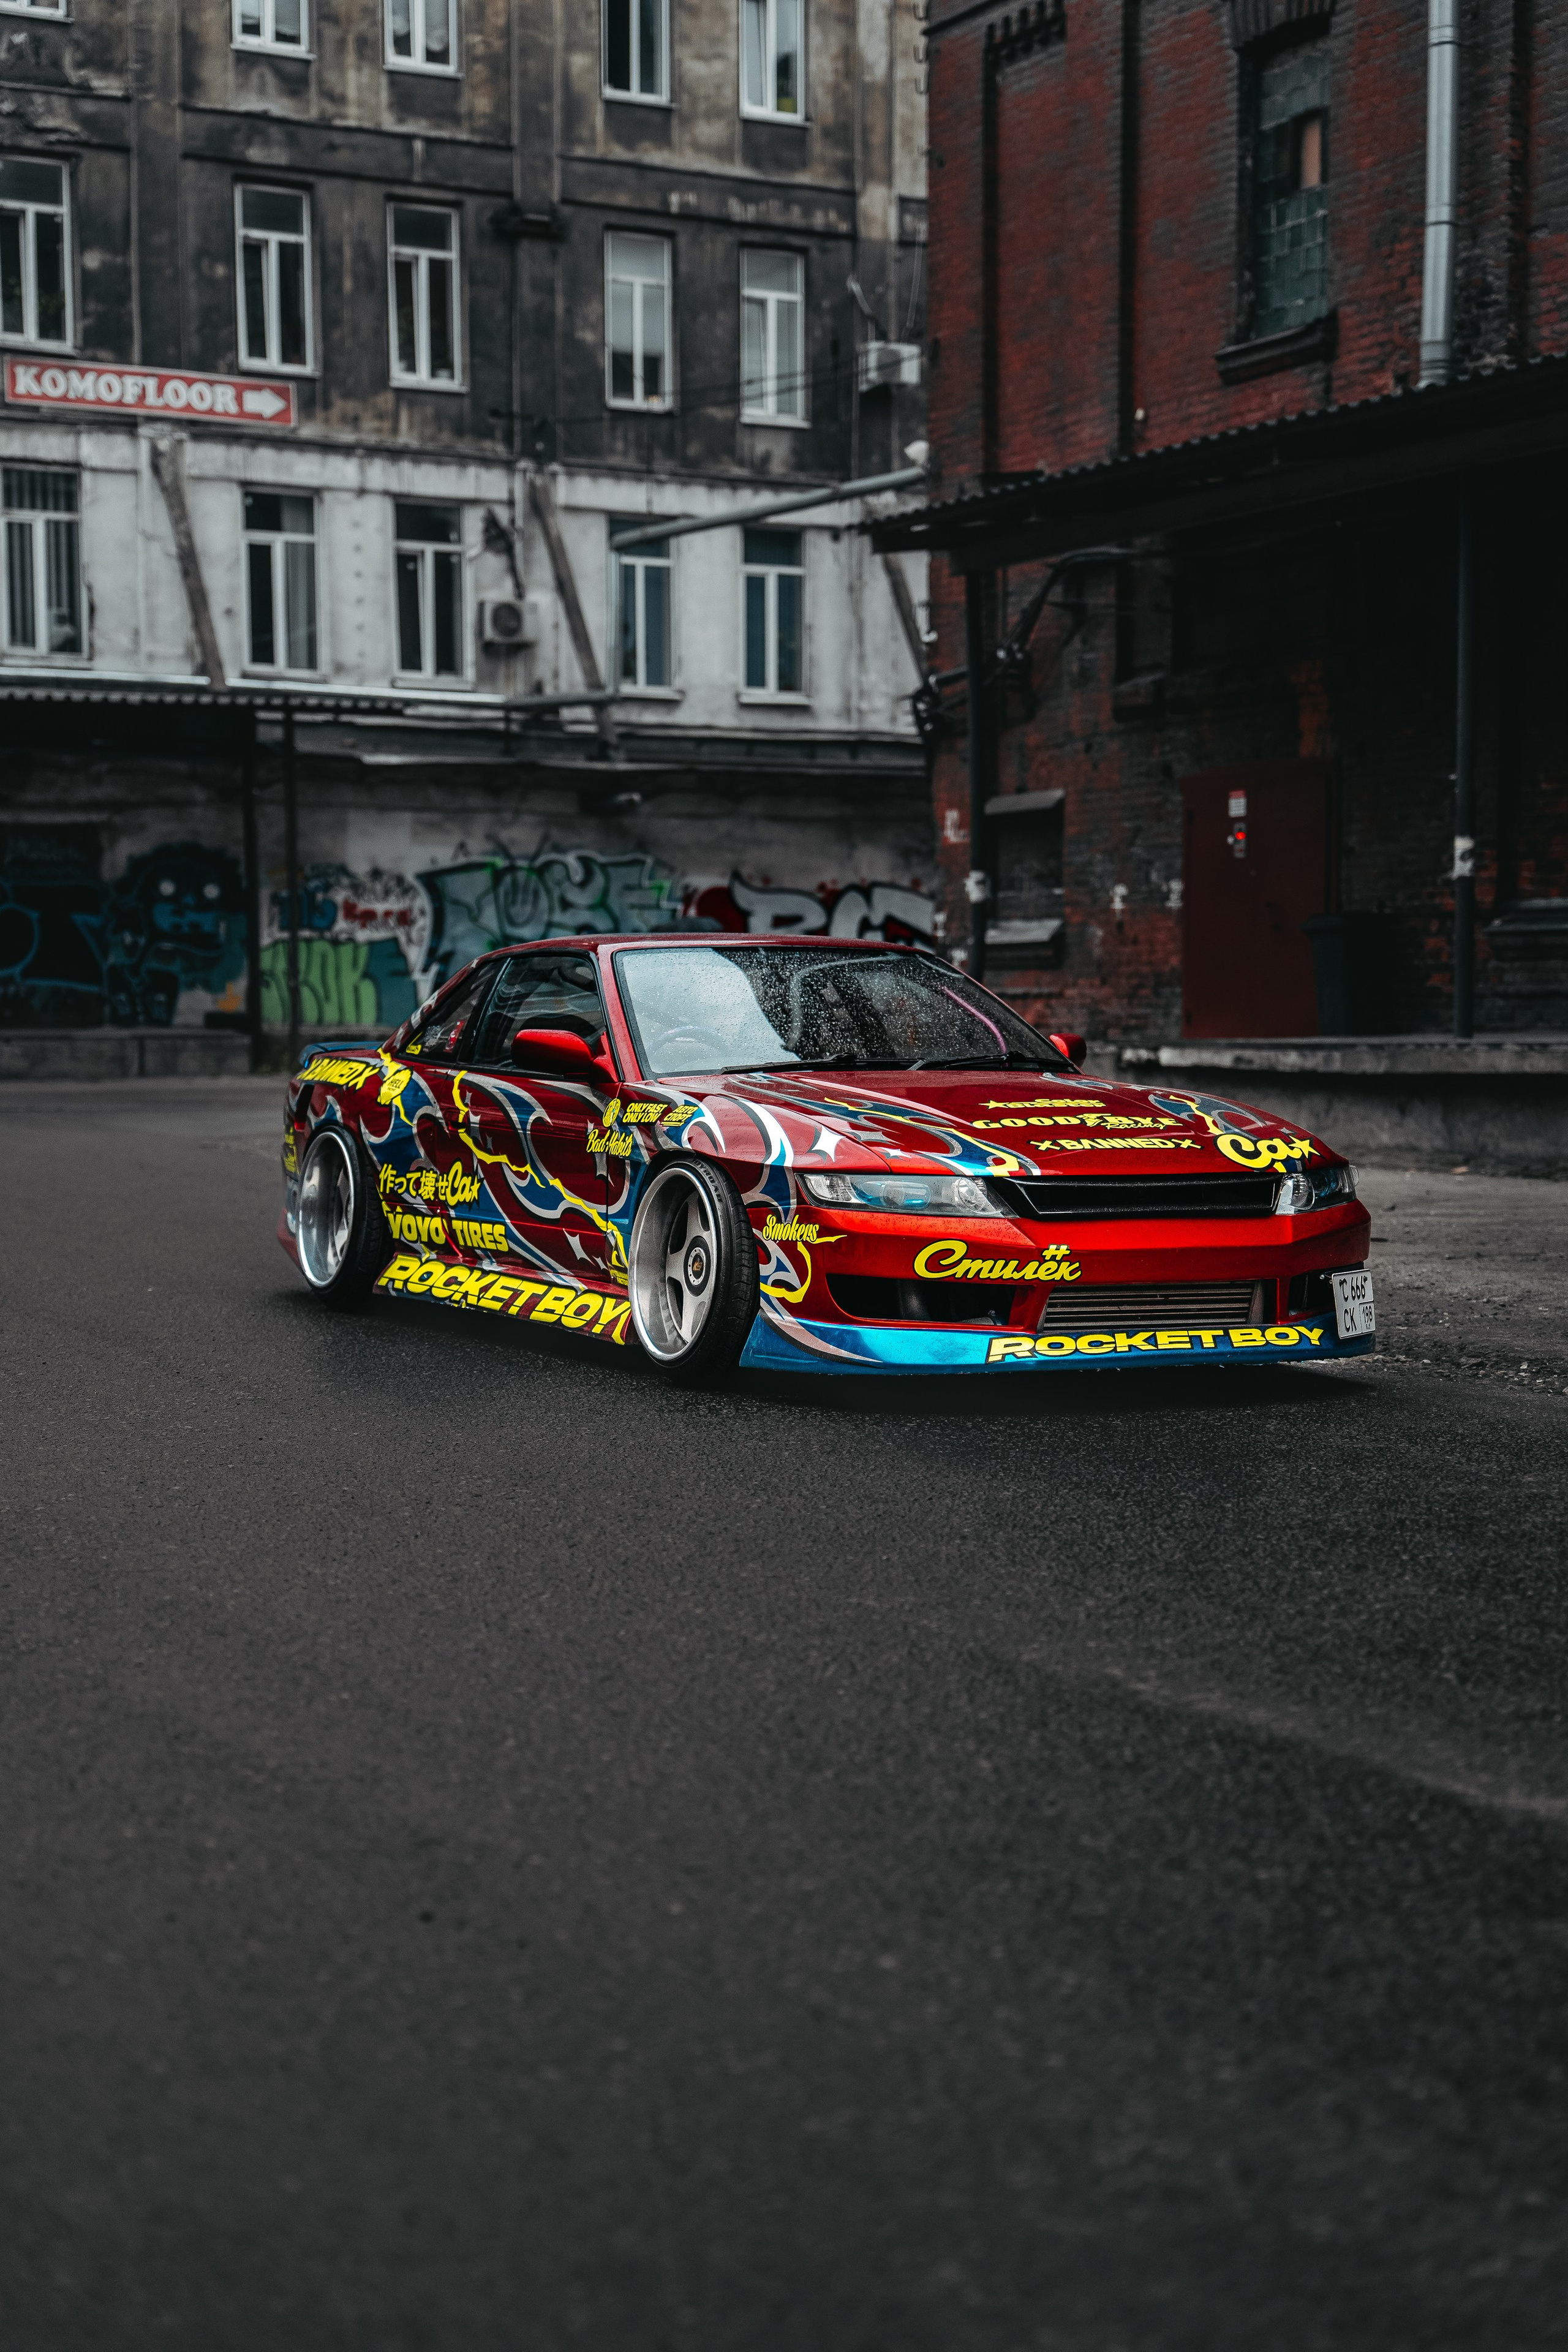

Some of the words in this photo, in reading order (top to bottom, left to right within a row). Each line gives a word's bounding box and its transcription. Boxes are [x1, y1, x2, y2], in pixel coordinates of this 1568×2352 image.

[15, 365, 238, 414] KOMOFLOOR
[641, 1113, 662, 1123] LOW
[644, 1104, 668, 1114] FAST
[971, 1116, 1081, 1129] GOOD
[379, 1163, 448, 1201] 作って壊せ
[387, 1213, 449, 1245] YOYO
[452, 1219, 510, 1252] TIRES
[1344, 1306, 1357, 1333] CK
[1362, 1305, 1373, 1324] 198
